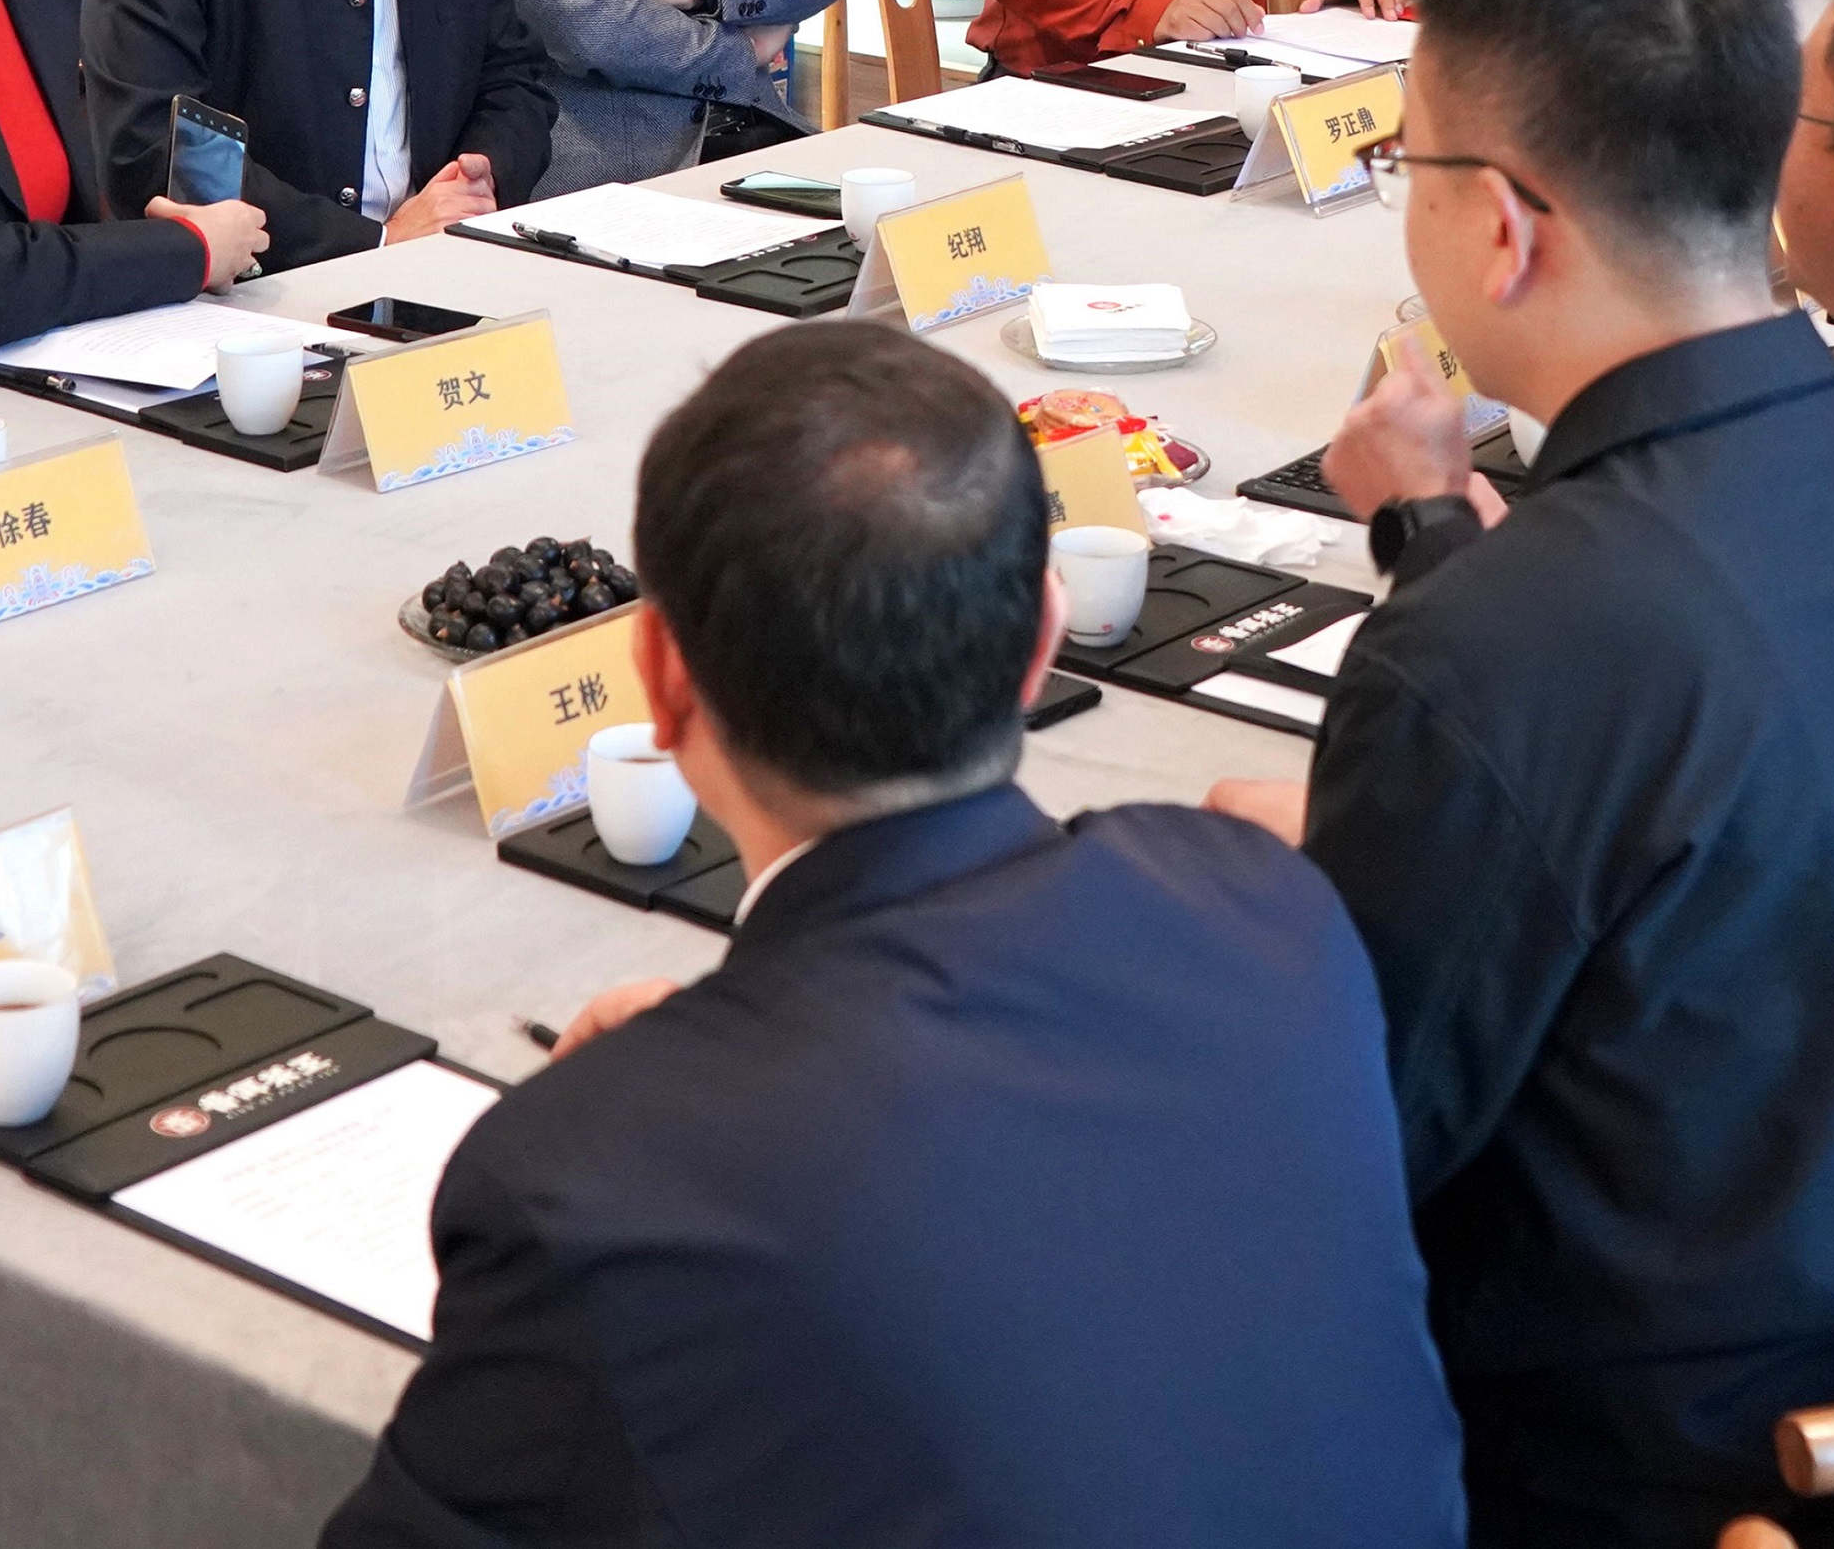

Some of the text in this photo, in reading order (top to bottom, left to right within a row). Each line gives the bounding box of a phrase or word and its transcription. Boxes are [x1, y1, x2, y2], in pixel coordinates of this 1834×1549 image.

[946, 225, 988, 262] 纪翔
[434, 369, 492, 412] 贺文
[549, 673, 609, 726] 王彬
